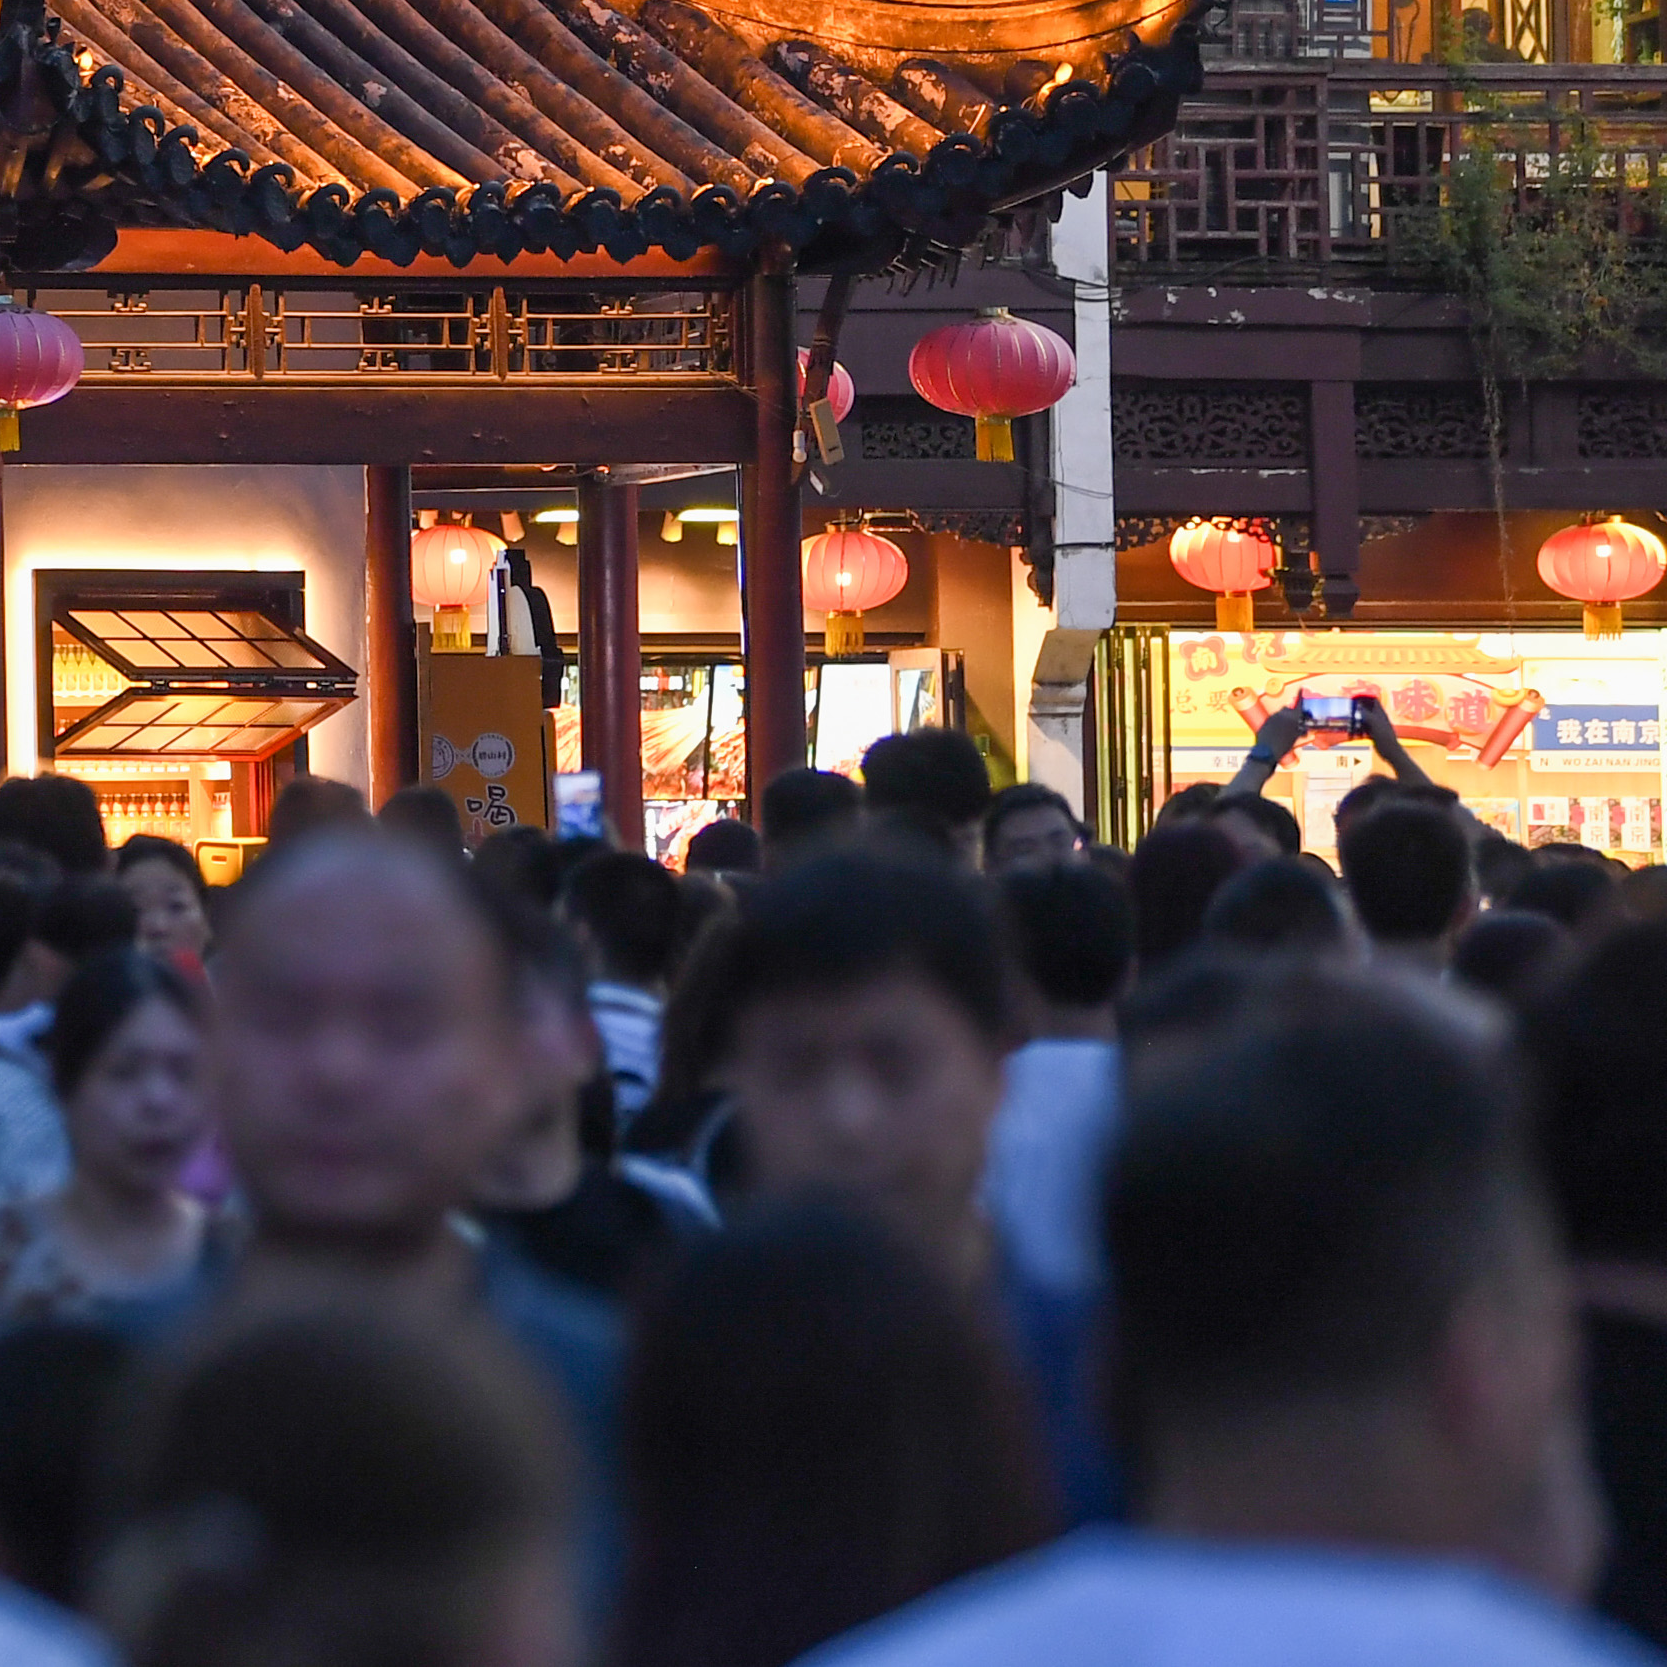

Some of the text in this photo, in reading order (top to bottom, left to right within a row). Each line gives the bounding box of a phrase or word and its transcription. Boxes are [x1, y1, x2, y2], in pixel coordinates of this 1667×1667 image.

[1557, 718, 1660, 745] 我在南京
[1540, 758, 1661, 767] N WO ZAI NAN JING
[466, 785, 516, 825] 喝
